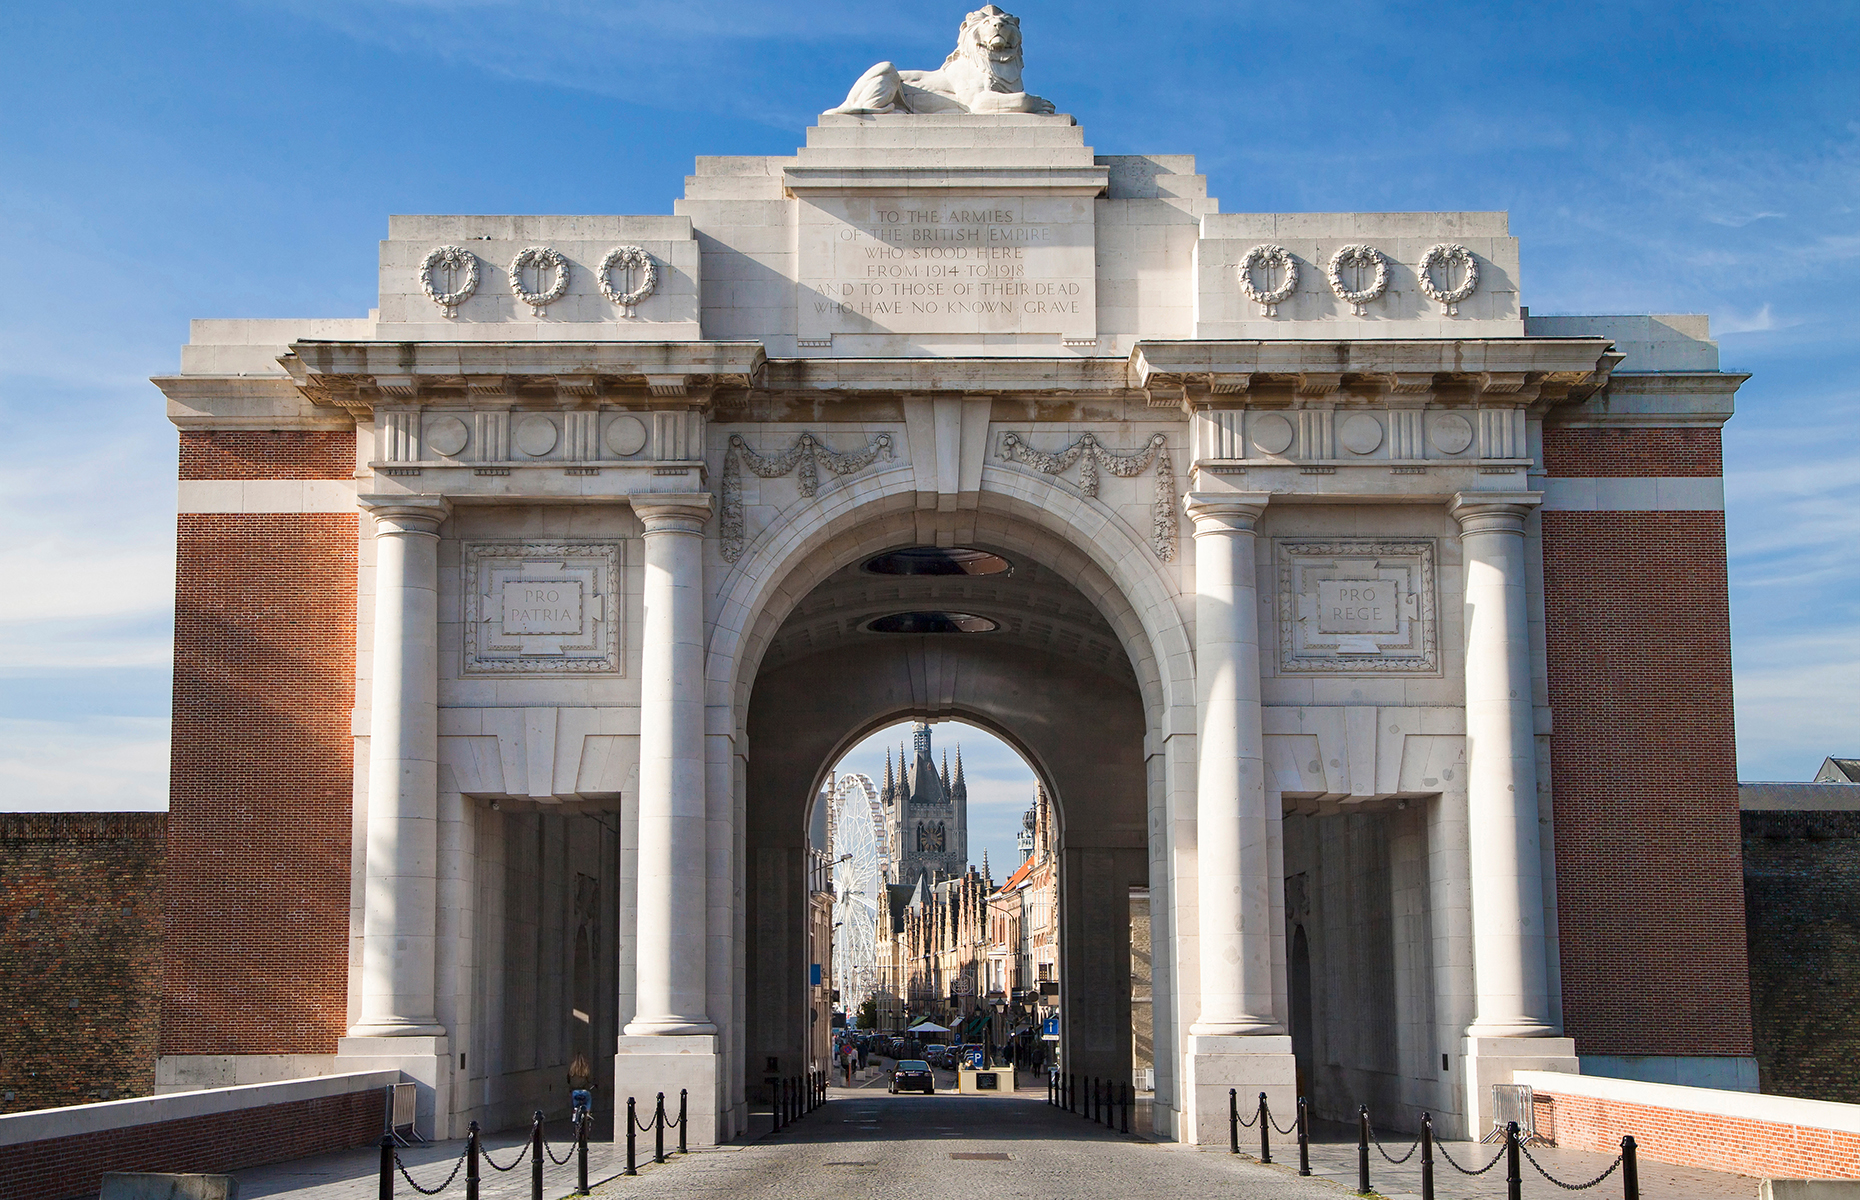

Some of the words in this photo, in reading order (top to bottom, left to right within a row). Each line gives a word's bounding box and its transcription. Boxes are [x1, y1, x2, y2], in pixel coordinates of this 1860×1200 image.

[877, 210, 899, 223] TO
[907, 210, 939, 223] THE
[949, 210, 1013, 223] ARMIES
[840, 228, 862, 241] OF
[872, 228, 902, 241] THE
[912, 228, 979, 241] BRITISH
[990, 228, 1050, 241] EMPIRE
[864, 246, 904, 259] WHO
[912, 246, 968, 259] STOOD
[976, 246, 1023, 259] HERE
[867, 264, 918, 277] FROM
[926, 264, 959, 277] 1914
[966, 264, 989, 277] TO
[994, 264, 1025, 277] 1918
[814, 282, 854, 295] AND
[860, 282, 883, 295] TO
[891, 282, 945, 295] THOSE
[953, 282, 974, 295] OF
[980, 282, 1030, 295] THEIR
[1035, 282, 1080, 295] DEAD
[814, 301, 854, 314] WHO
[861, 301, 903, 314] HAVE
[912, 301, 938, 314] NO
[947, 301, 1013, 314] KNOWN
[1024, 301, 1079, 314] GRAVE
[525, 590, 559, 602] PRO
[1340, 589, 1375, 601] PRO
[511, 609, 572, 621] PATRIA
[1333, 607, 1382, 620] REGE
[974, 1053, 982, 1063] P
